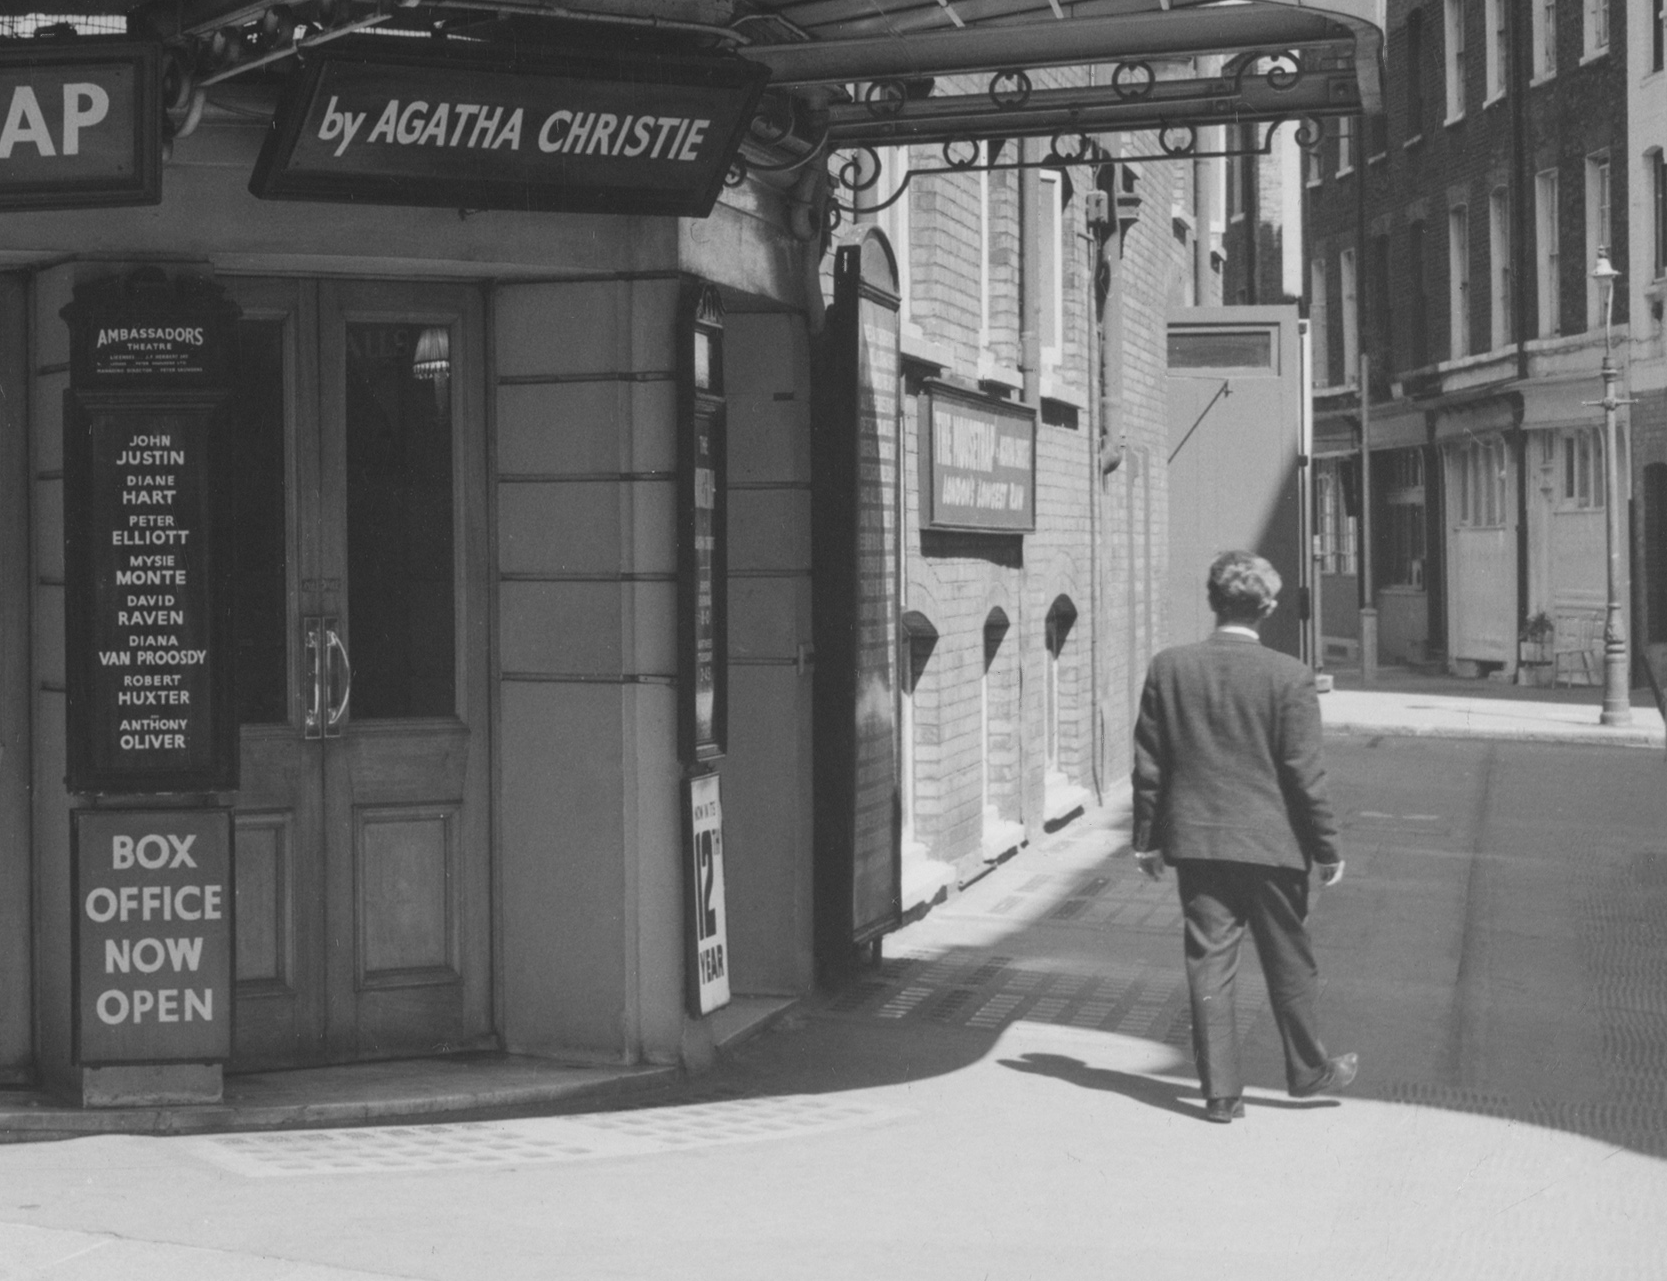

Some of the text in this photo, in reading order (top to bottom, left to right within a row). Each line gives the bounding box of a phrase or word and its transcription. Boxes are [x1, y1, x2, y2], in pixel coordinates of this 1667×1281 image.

[318, 96, 711, 161] by AGATHA CHRISTIE
[97, 327, 203, 348] AMBASSADORS
[127, 342, 172, 351] THEATRE
[129, 435, 171, 447] JOHN
[116, 450, 185, 465] JUSTIN
[126, 475, 175, 486] DIANE
[122, 490, 176, 505] HART
[129, 515, 175, 527] PETER
[112, 530, 189, 545] ELLIOTT
[130, 555, 175, 567] MYSIE
[115, 570, 187, 585] MONTE
[127, 595, 175, 607] DAVID
[118, 610, 184, 626] RAVEN
[129, 635, 179, 647] DIANA
[99, 650, 207, 666] VAN PROOSDY
[124, 674, 182, 686] ROBERT
[118, 690, 190, 705] HUXTER
[119, 719, 188, 731] ANTHONY
[120, 734, 186, 750] OLIVER
[112, 833, 199, 870] BOX
[85, 884, 222, 923] OFFICE
[105, 937, 204, 974] NOW
[96, 988, 214, 1026] OPEN
